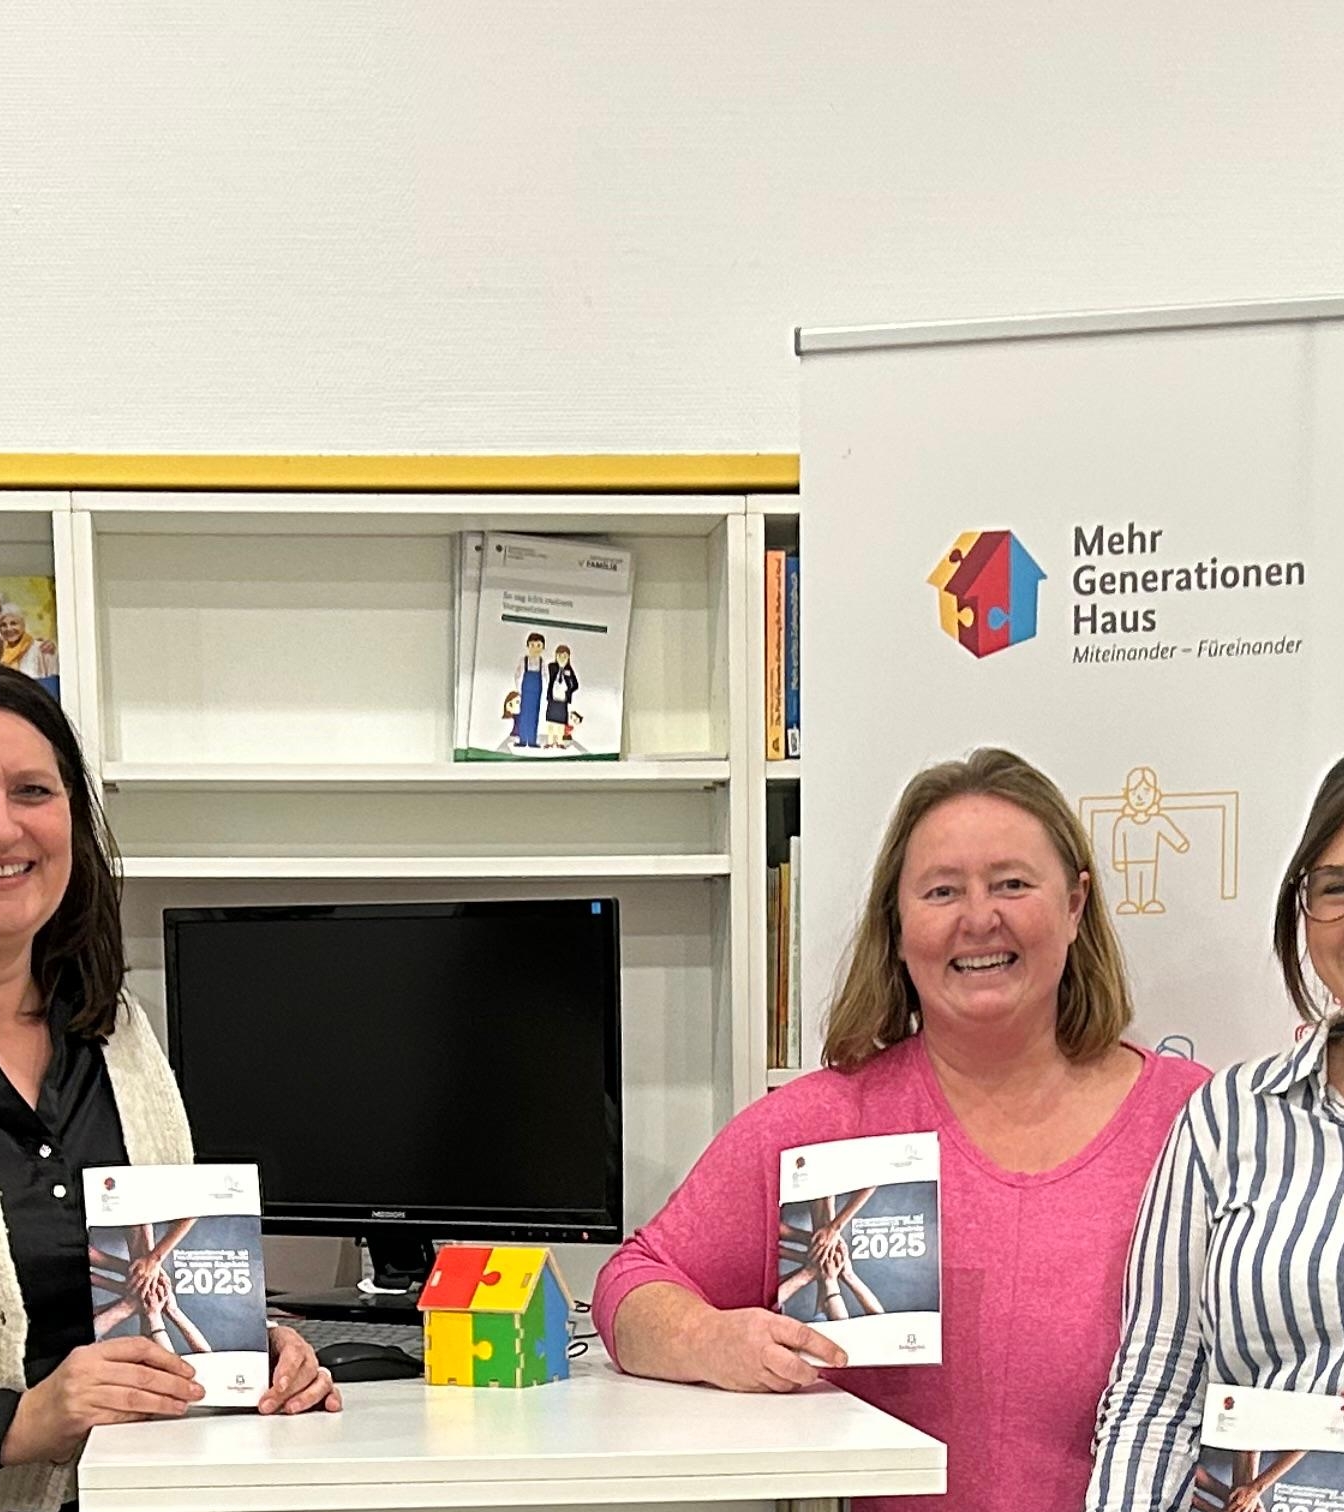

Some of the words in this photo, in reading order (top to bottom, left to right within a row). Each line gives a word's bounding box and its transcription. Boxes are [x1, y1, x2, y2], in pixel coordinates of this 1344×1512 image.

[1073, 522, 1163, 557] Mehr
[1072, 557, 1306, 596] Generationen
[1072, 604, 1158, 636] Haus
[1072, 641, 1177, 664] Miteinander
[1196, 636, 1304, 659] Füreinander
[851, 1232, 927, 1261] 2025
[174, 1268, 253, 1295] 2025
